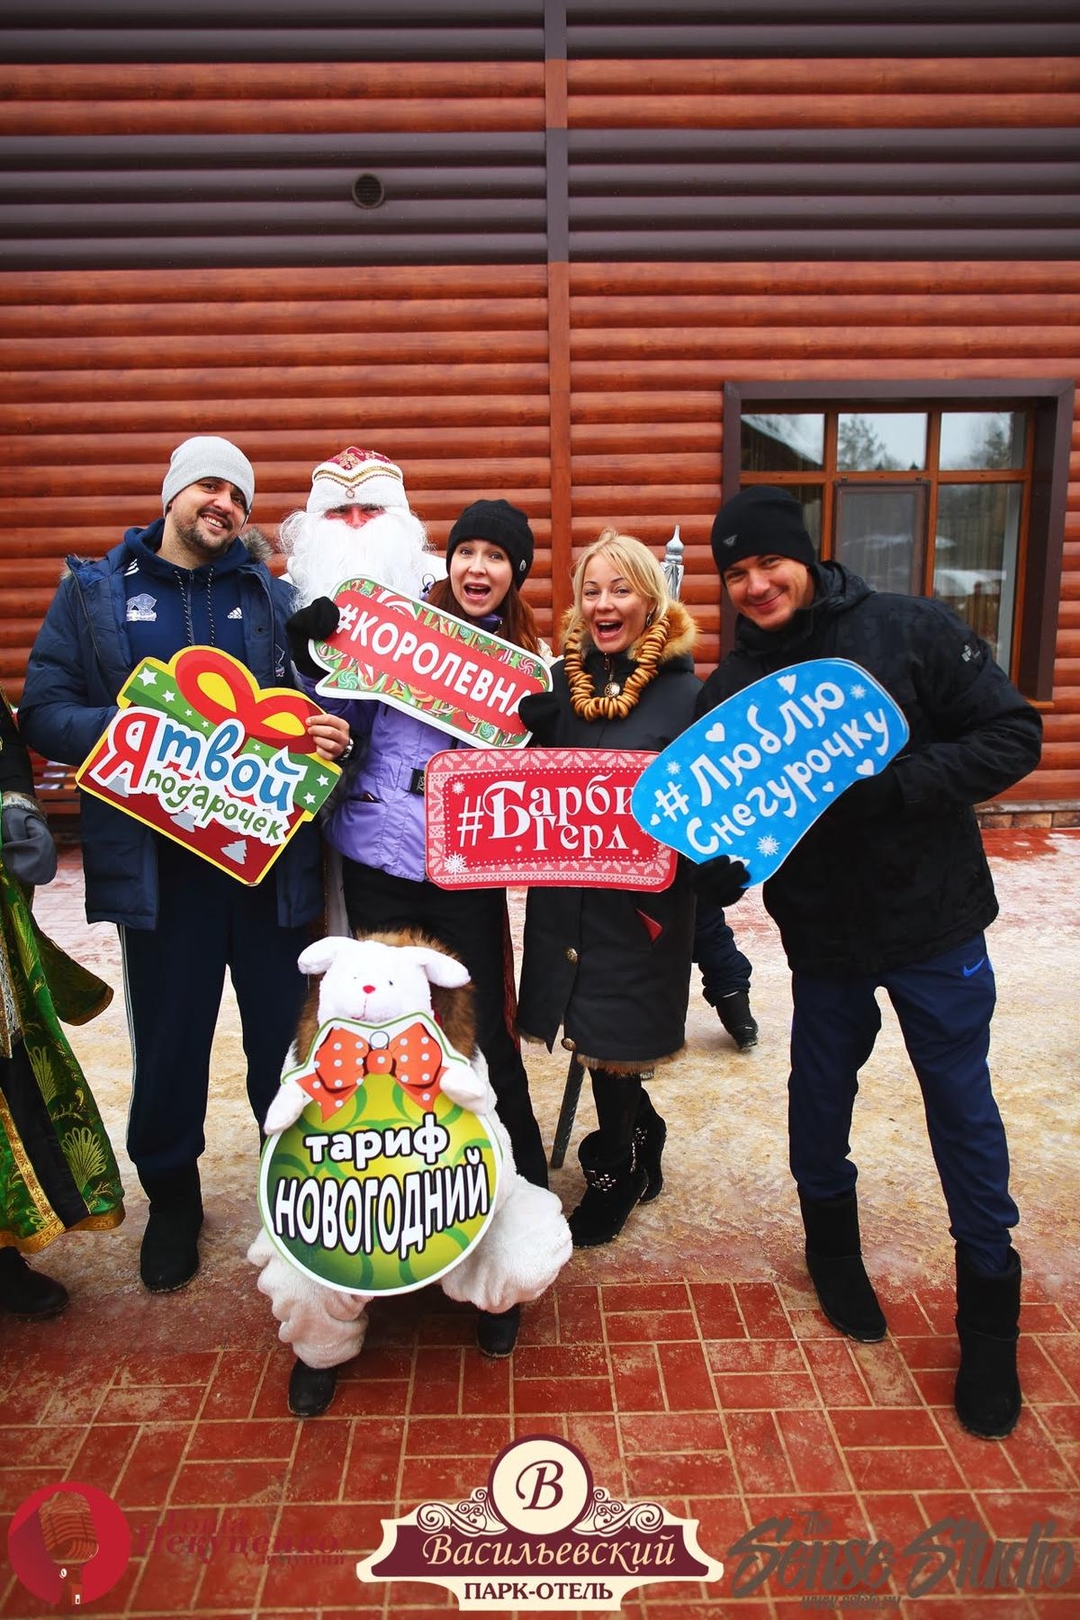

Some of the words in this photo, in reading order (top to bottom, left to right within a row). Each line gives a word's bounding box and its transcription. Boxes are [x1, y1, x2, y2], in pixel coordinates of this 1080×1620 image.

[97, 711, 161, 789] Я
[157, 723, 300, 812] твой
[686, 708, 890, 855] Снегурочку
[144, 769, 283, 841] подарочек
[304, 1113, 449, 1169] тариф
